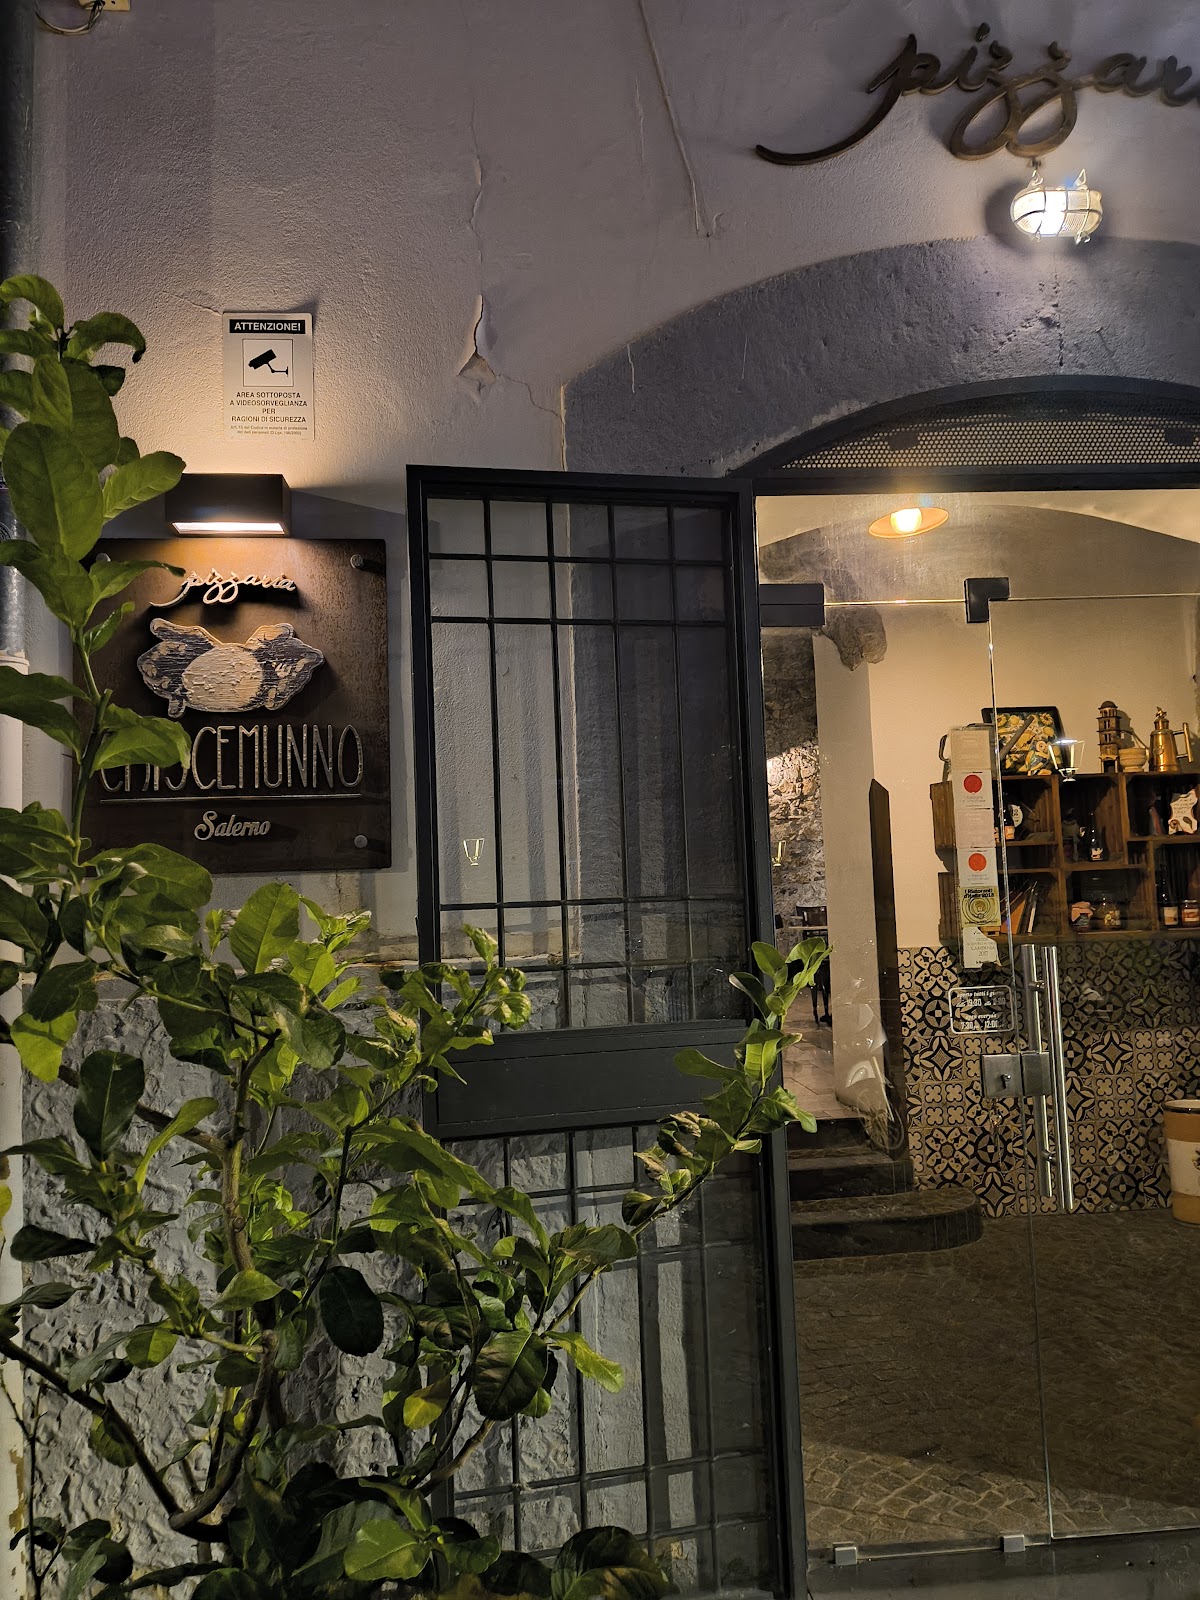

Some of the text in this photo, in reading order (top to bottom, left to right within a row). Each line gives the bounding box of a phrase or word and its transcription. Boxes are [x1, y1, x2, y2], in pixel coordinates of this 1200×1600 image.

[754, 22, 1200, 166] pizzar
[234, 322, 301, 331] ATTENZIONE!
[150, 568, 296, 607] pizzaria
[194, 810, 271, 841] Salerno
